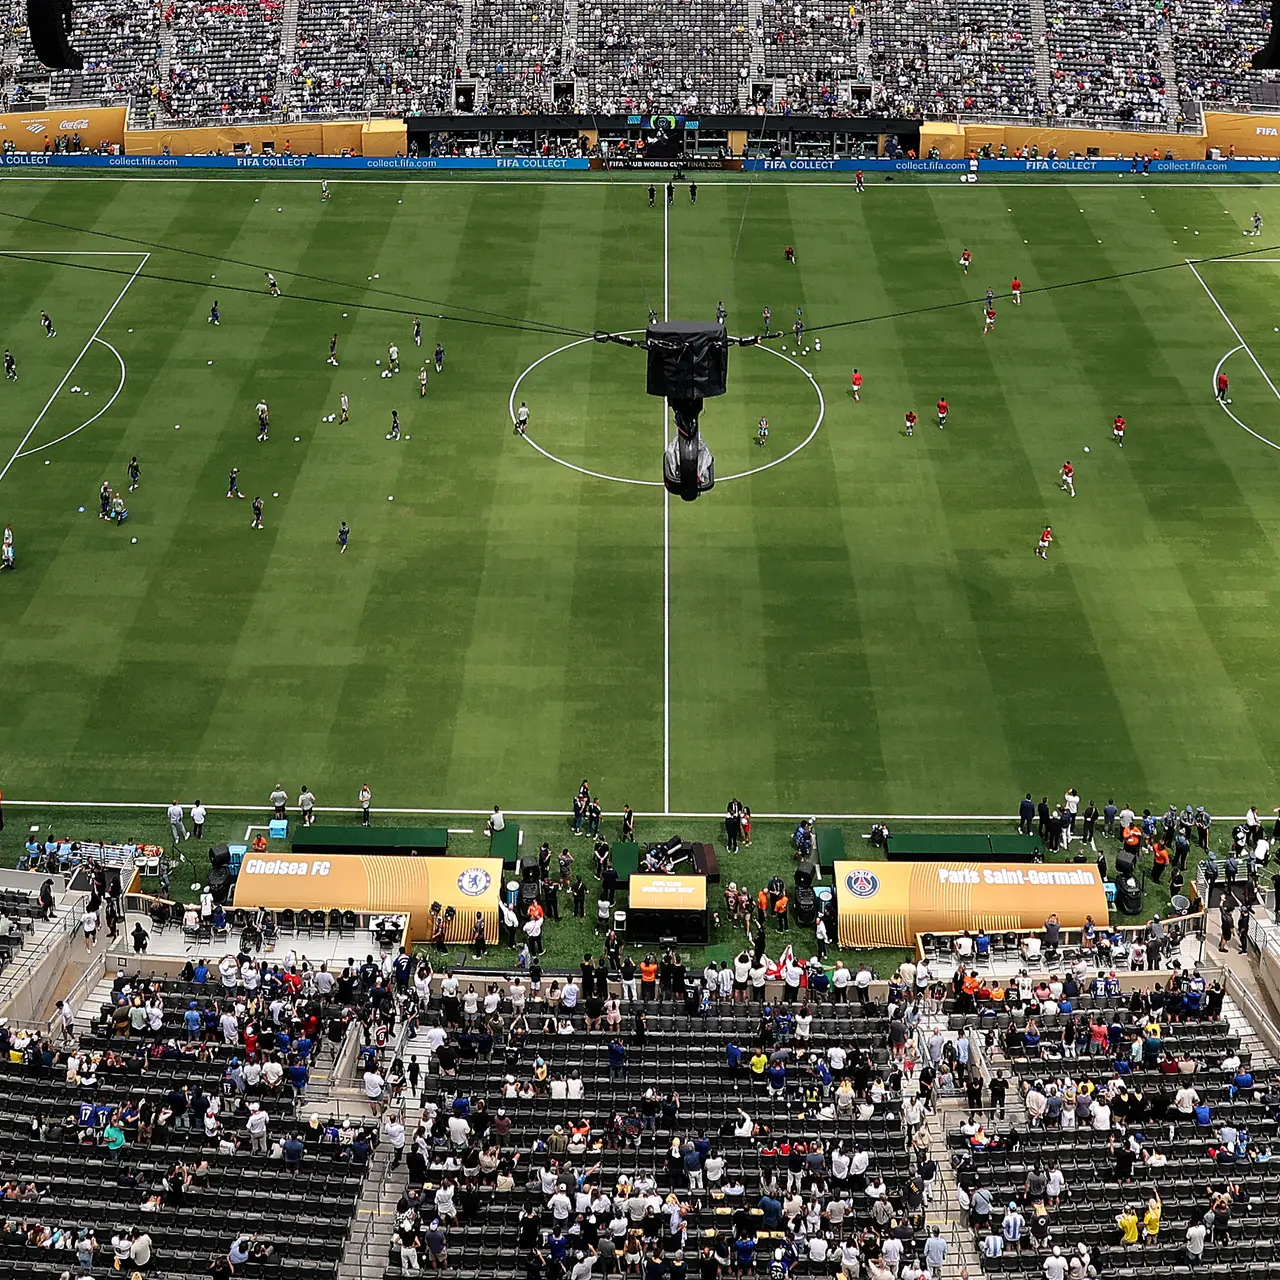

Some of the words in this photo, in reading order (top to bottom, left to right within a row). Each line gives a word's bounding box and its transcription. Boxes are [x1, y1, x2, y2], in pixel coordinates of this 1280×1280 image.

[1255, 127, 1279, 136] FIFA
[6, 156, 50, 165] COLLECT
[109, 156, 178, 167] collect.fifa.com
[237, 157, 260, 167] FIFA
[262, 157, 307, 167] COLLECT
[367, 158, 437, 169] collect.fifa.com
[496, 158, 520, 168] FIFA
[522, 158, 567, 168] COLLECT
[609, 160, 624, 168] FIFA
[643, 160, 667, 169] WORLD
[687, 160, 706, 168] FINAL
[707, 160, 722, 168] 2025
[764, 160, 787, 169] FIFA
[789, 160, 835, 169] COLLECT
[895, 160, 966, 171] collect.fifa.com
[1025, 161, 1049, 170] FIFA
[1052, 161, 1097, 170] COLLECT
[1157, 161, 1228, 172] collect.fifa.com
[245, 858, 307, 876] Chelsea
[310, 859, 331, 877] FC
[938, 868, 981, 885] Paris
[983, 869, 1095, 885] Saint-Germain
[401, 962, 408, 971] 7
